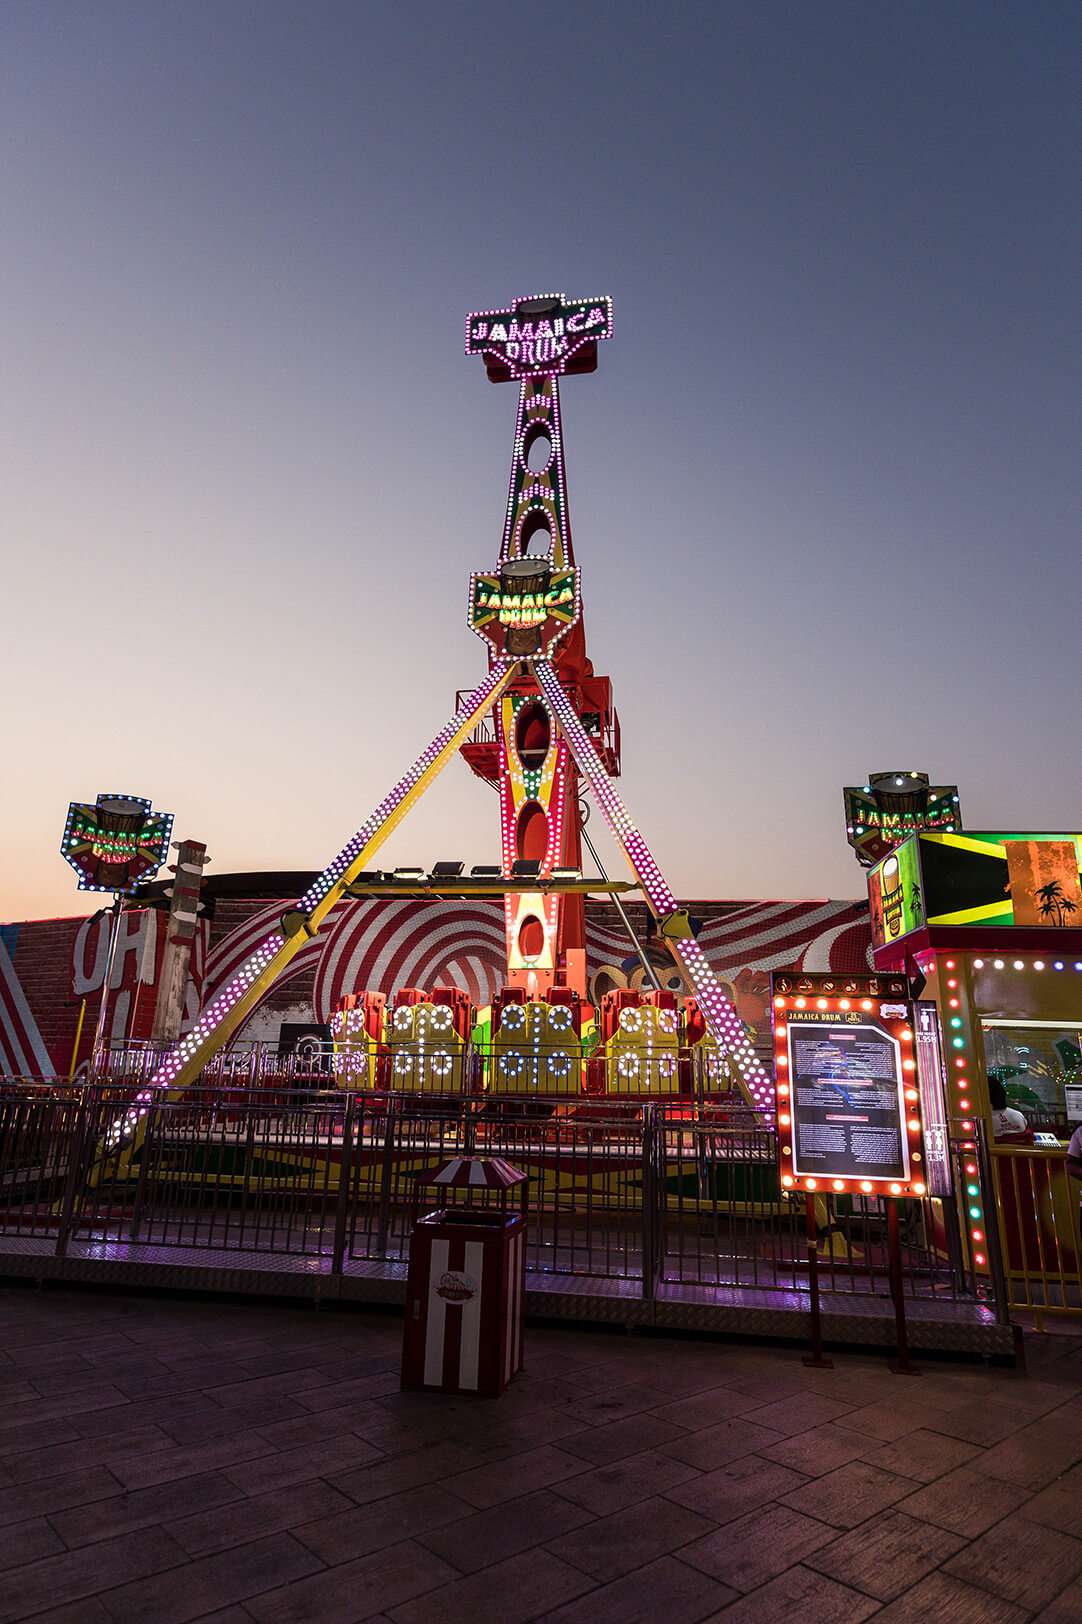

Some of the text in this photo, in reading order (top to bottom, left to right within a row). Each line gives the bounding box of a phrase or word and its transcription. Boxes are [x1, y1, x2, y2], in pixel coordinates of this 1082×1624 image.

[472, 308, 606, 341] JAMAICA
[477, 587, 574, 609] JAMAICA
[856, 808, 955, 829] JAMAICA
[71, 823, 163, 848] JAMAICA
[788, 1011, 819, 1021] JAMAICA
[821, 1013, 842, 1022] DRUM
